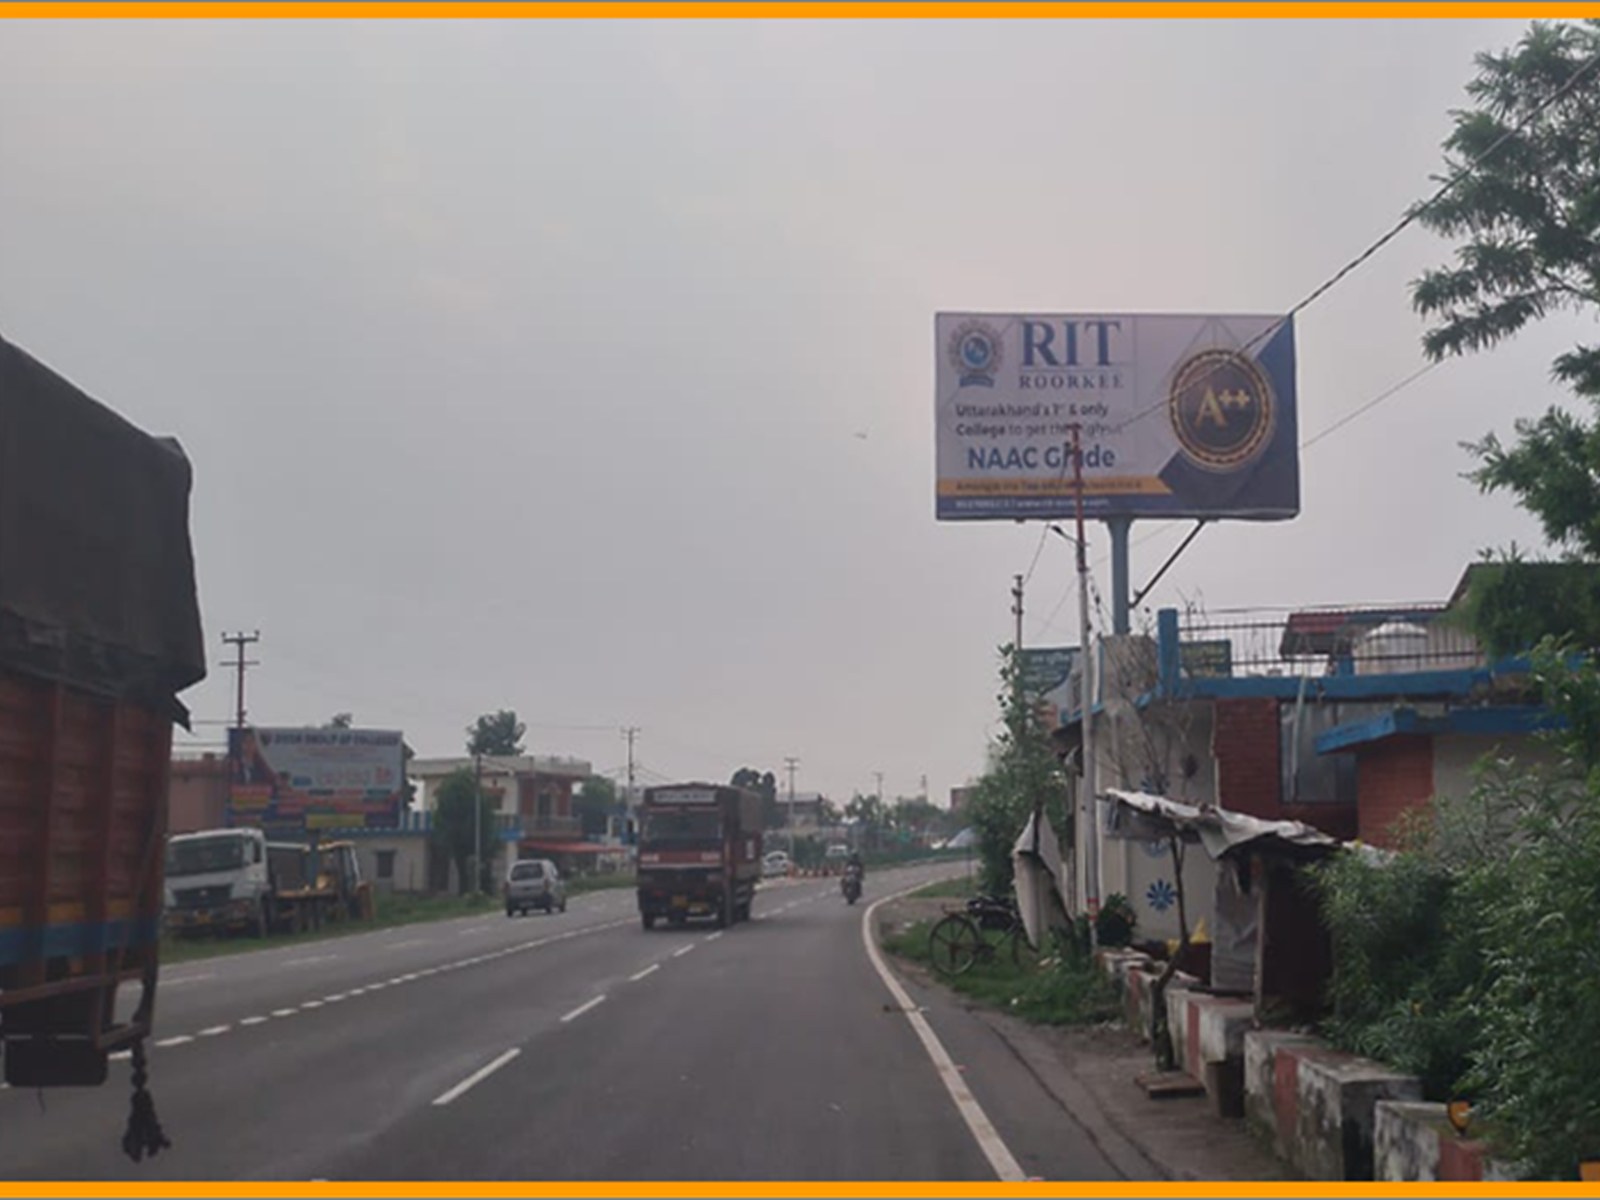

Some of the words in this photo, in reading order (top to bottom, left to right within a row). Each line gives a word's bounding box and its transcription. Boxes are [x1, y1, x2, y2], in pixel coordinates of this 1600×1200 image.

[1020, 321, 1121, 366] RIT
[1018, 374, 1124, 389] ROORKEE
[956, 403, 1049, 417] Uttarakhand's
[1069, 403, 1077, 415] &
[1080, 402, 1109, 418] only
[1194, 386, 1250, 428] A++
[956, 423, 1005, 439] College
[1009, 423, 1023, 435] to
[1026, 424, 1046, 438] get
[968, 447, 1038, 468] NAAC
